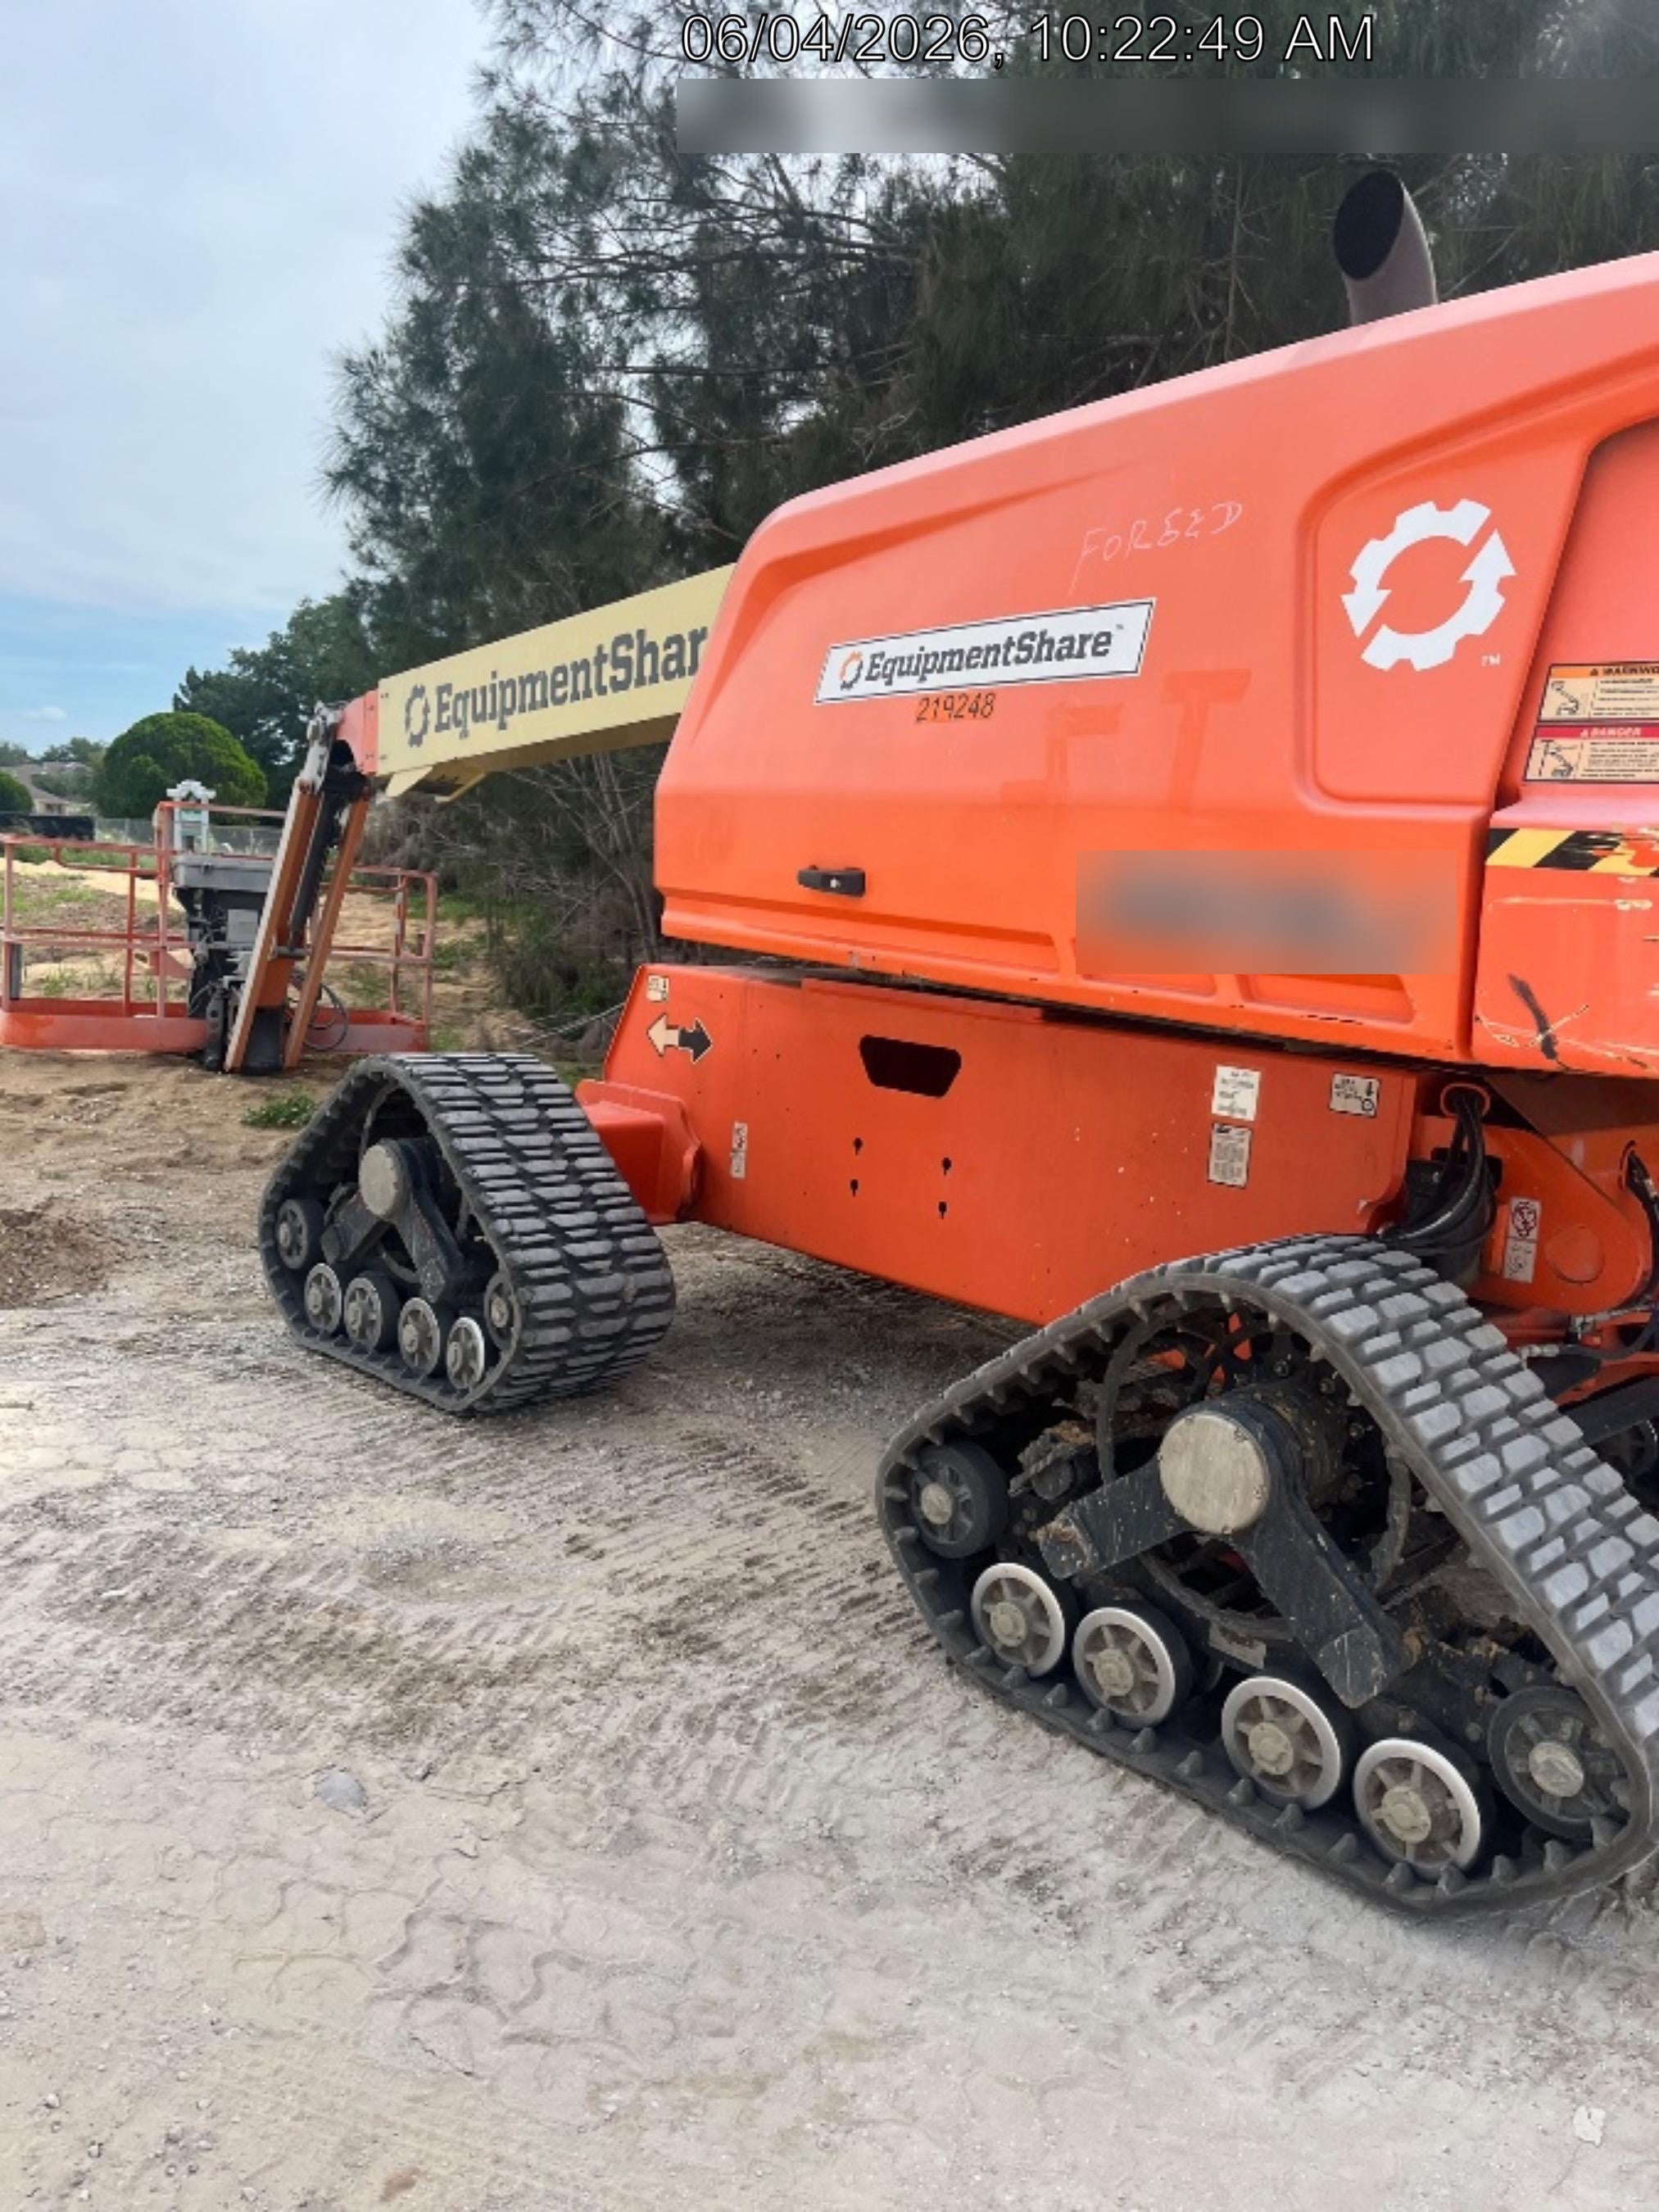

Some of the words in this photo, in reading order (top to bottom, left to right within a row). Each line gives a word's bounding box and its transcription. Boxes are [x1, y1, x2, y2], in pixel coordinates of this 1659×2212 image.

[435, 626, 708, 739] EquipmentShar
[865, 629, 1113, 687] EquipmentShare
[916, 692, 996, 723] 219248
